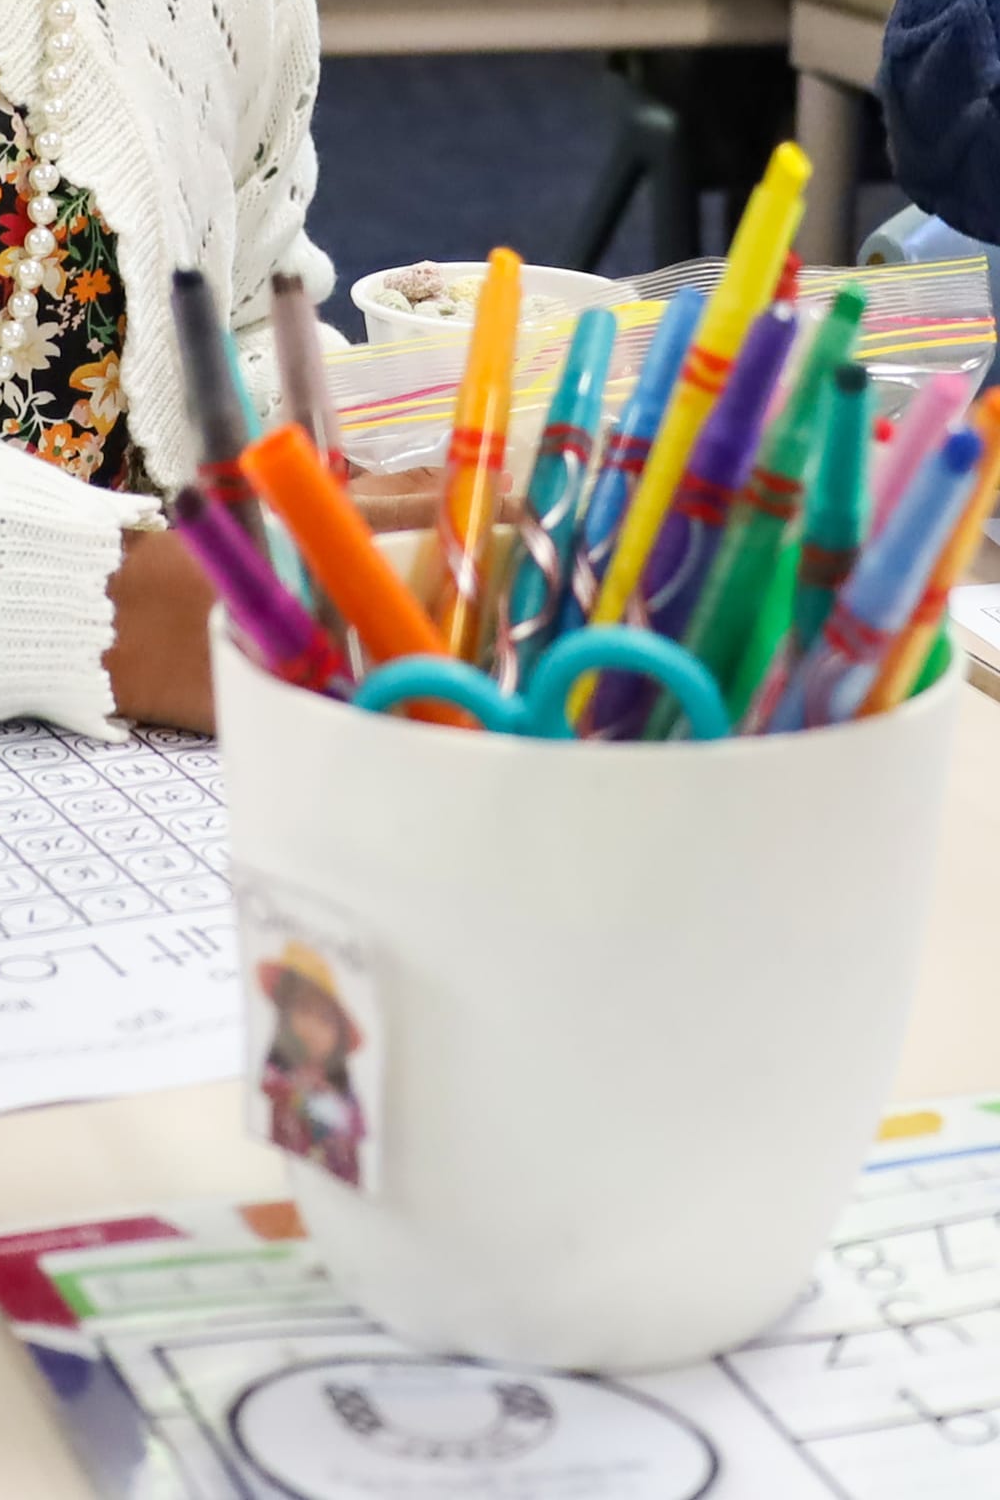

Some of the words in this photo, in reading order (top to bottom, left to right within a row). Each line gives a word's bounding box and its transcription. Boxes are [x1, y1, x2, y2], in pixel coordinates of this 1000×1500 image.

[12, 746, 58, 761] 55
[112, 764, 162, 778] 44
[42, 772, 88, 786] 45
